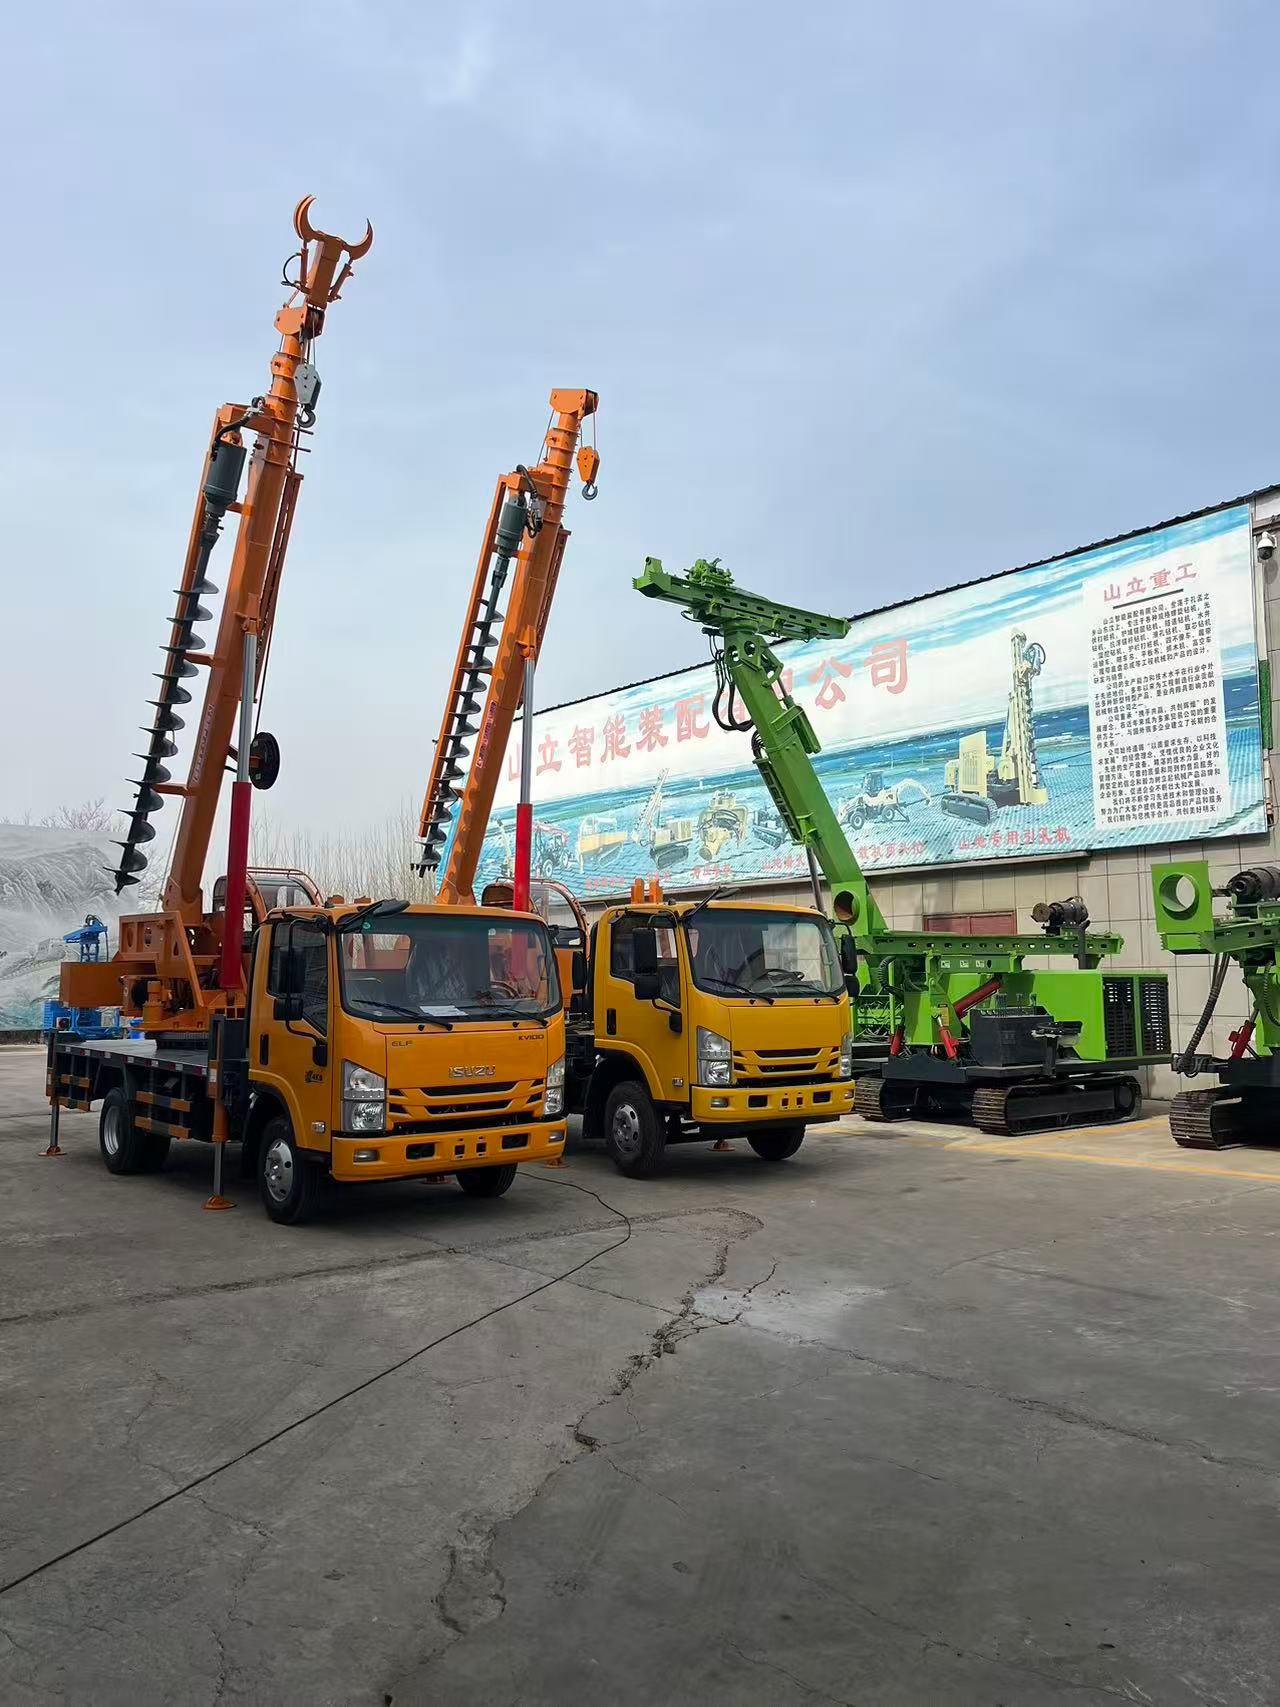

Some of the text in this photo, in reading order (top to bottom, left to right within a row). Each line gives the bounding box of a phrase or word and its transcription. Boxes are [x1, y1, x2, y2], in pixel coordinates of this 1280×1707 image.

[1104, 563, 1197, 602] 山立重工
[448, 1064, 497, 1079] ISUZU
